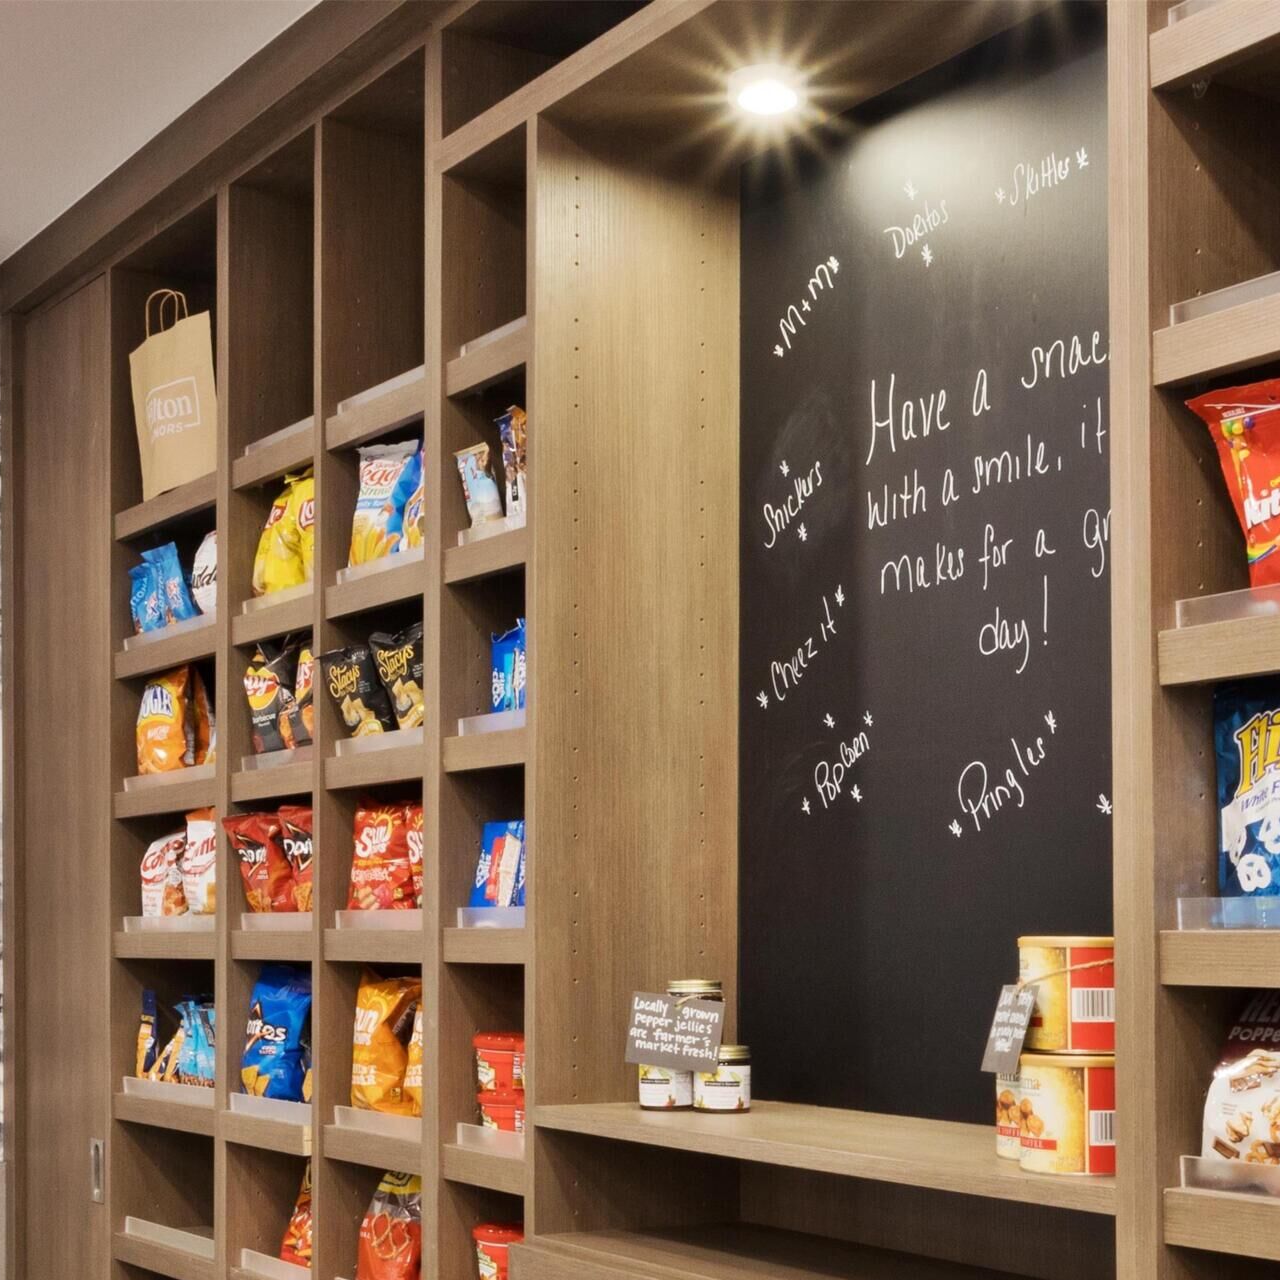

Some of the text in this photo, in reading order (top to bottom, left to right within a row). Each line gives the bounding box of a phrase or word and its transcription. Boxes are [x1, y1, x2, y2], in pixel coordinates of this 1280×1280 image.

[866, 330, 1110, 466] Have a snac
[763, 460, 824, 549] Snickers
[942, 469, 960, 506] a
[880, 542, 966, 595] makes
[978, 524, 1014, 590] for
[1034, 529, 1057, 558] a
[771, 636, 819, 701] Cheez
[957, 737, 1047, 832] Pringles
[629, 1026, 648, 1039] are
[633, 996, 720, 1024] Locally grown
[634, 1012, 713, 1035] pepper jellies
[635, 1039, 719, 1062] market fresh!
